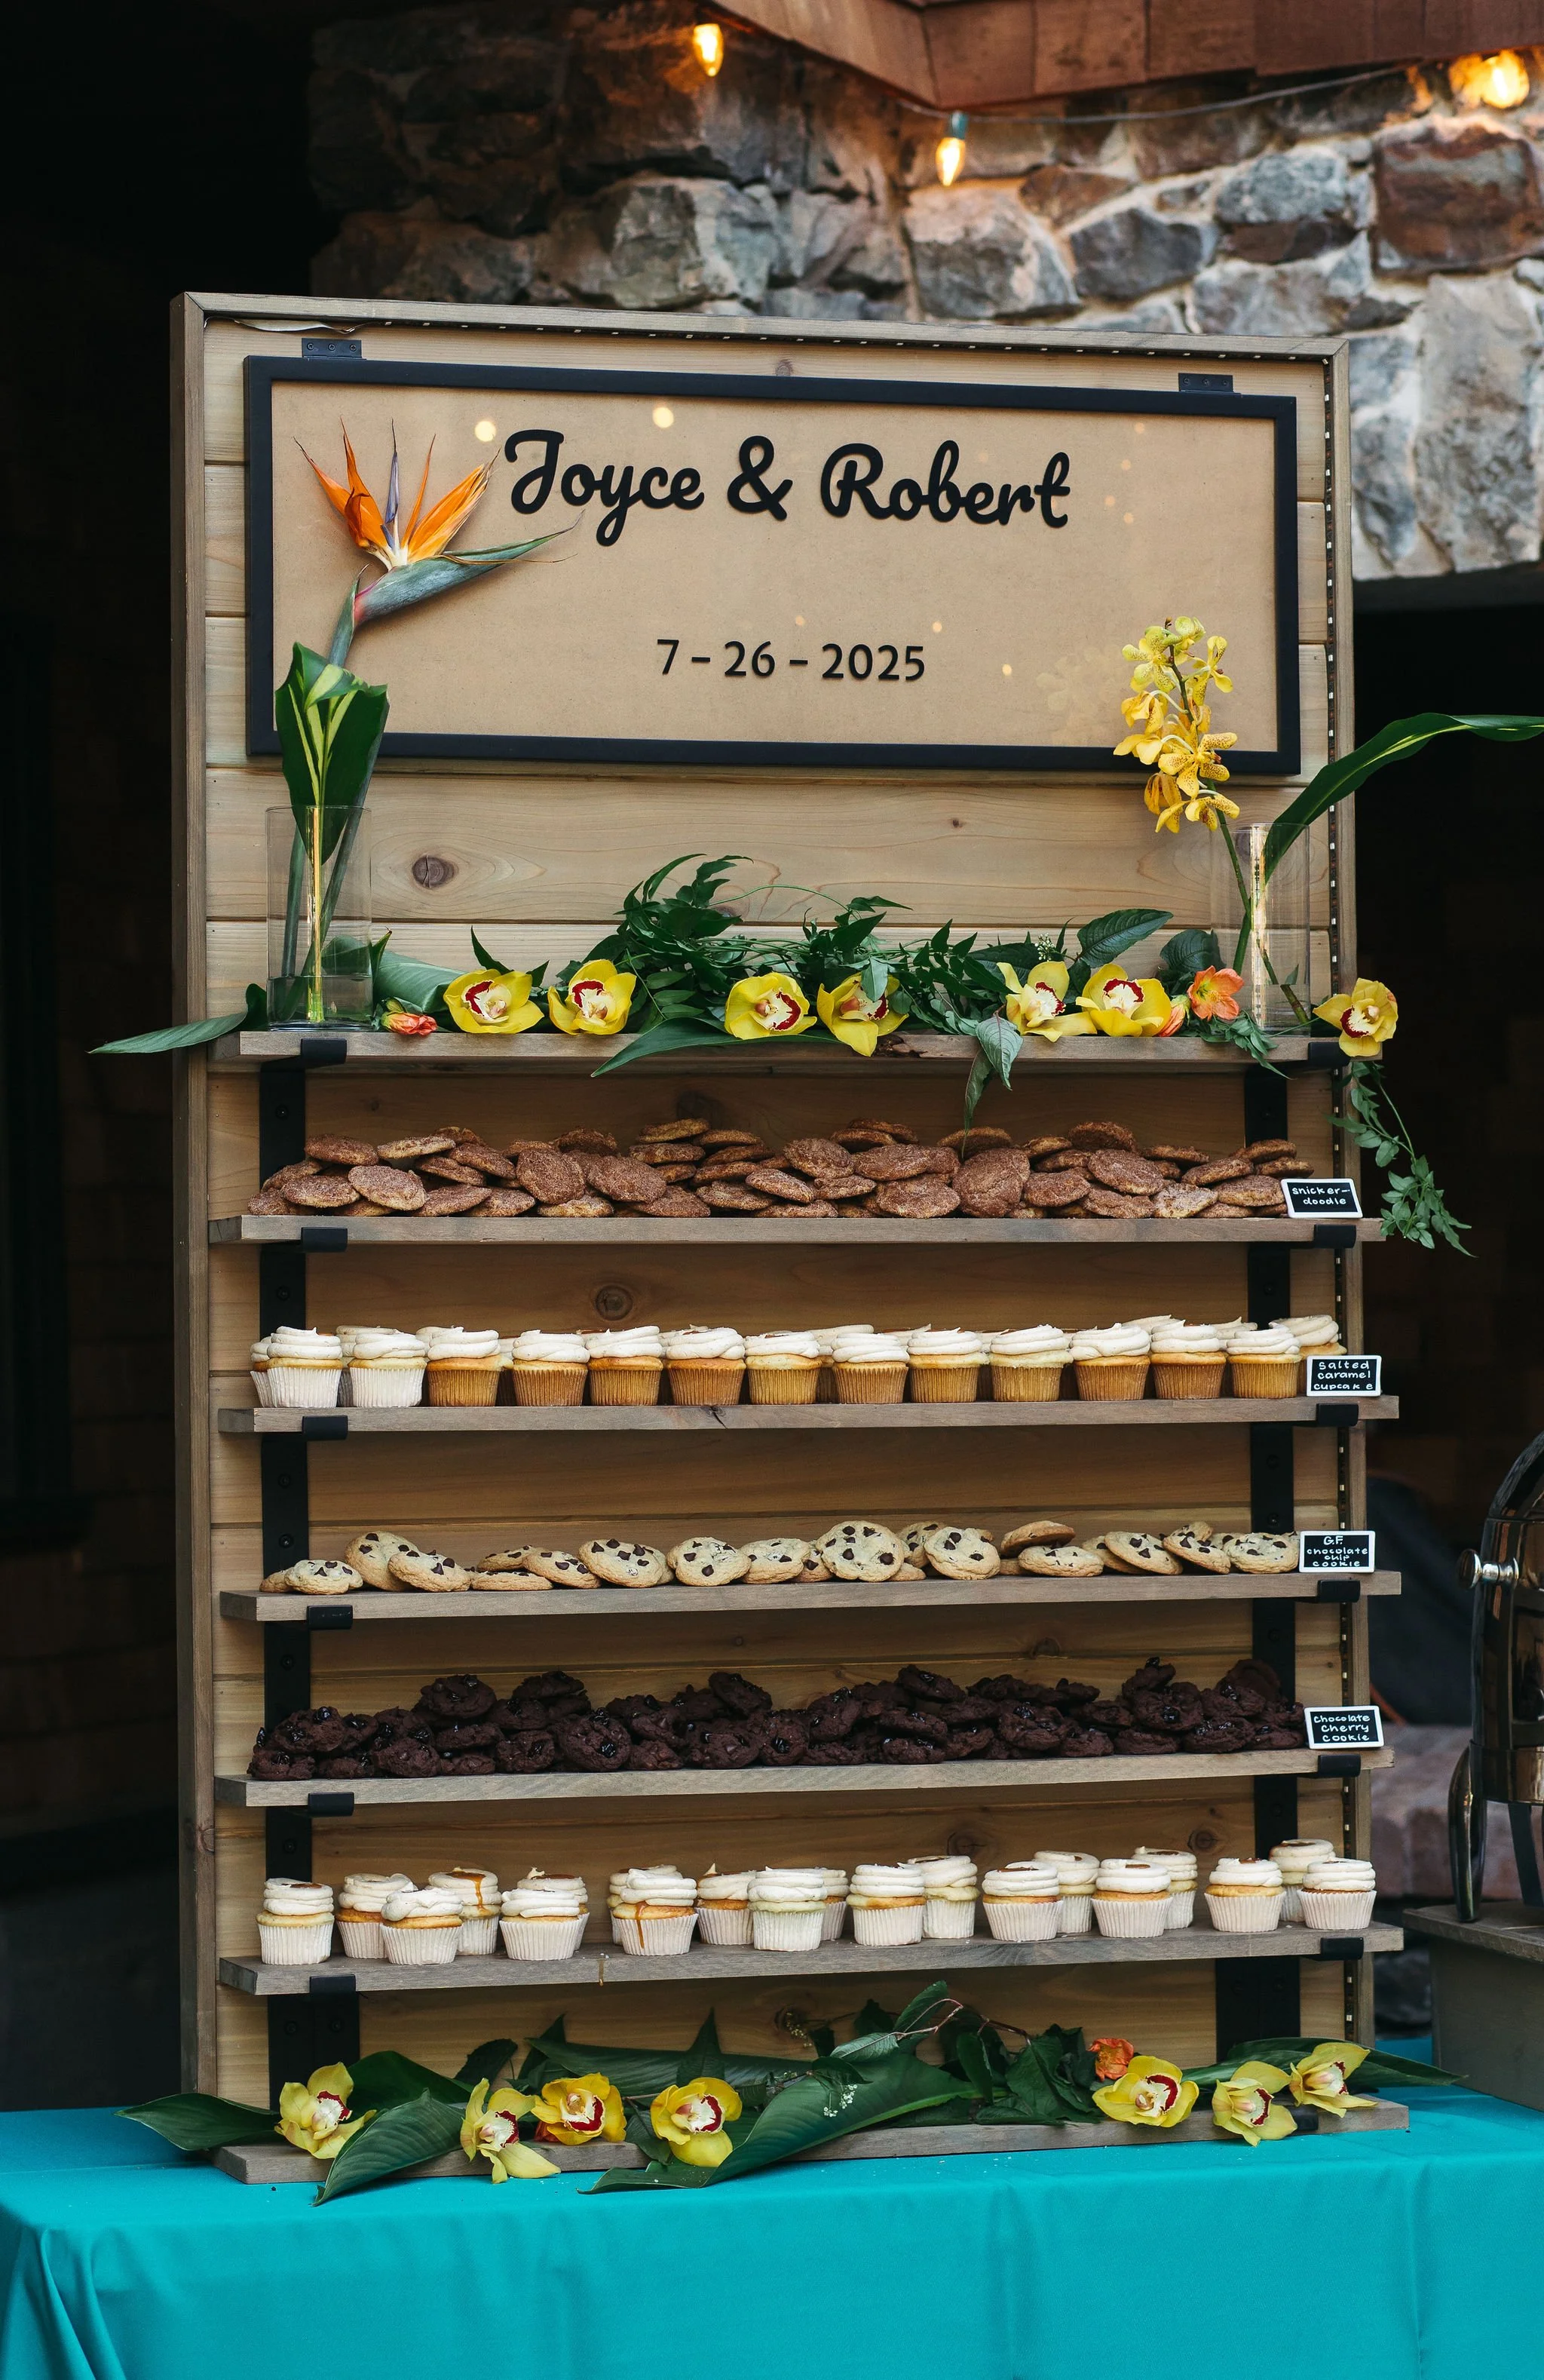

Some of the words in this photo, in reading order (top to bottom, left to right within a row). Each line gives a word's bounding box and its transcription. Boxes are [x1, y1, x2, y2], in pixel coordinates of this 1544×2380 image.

[504, 430, 704, 547] Joyce
[728, 436, 792, 521] &
[820, 440, 1070, 529] Robert
[1317, 1370, 1371, 1379] caramel
[1323, 1535, 1343, 1545] G.F.
